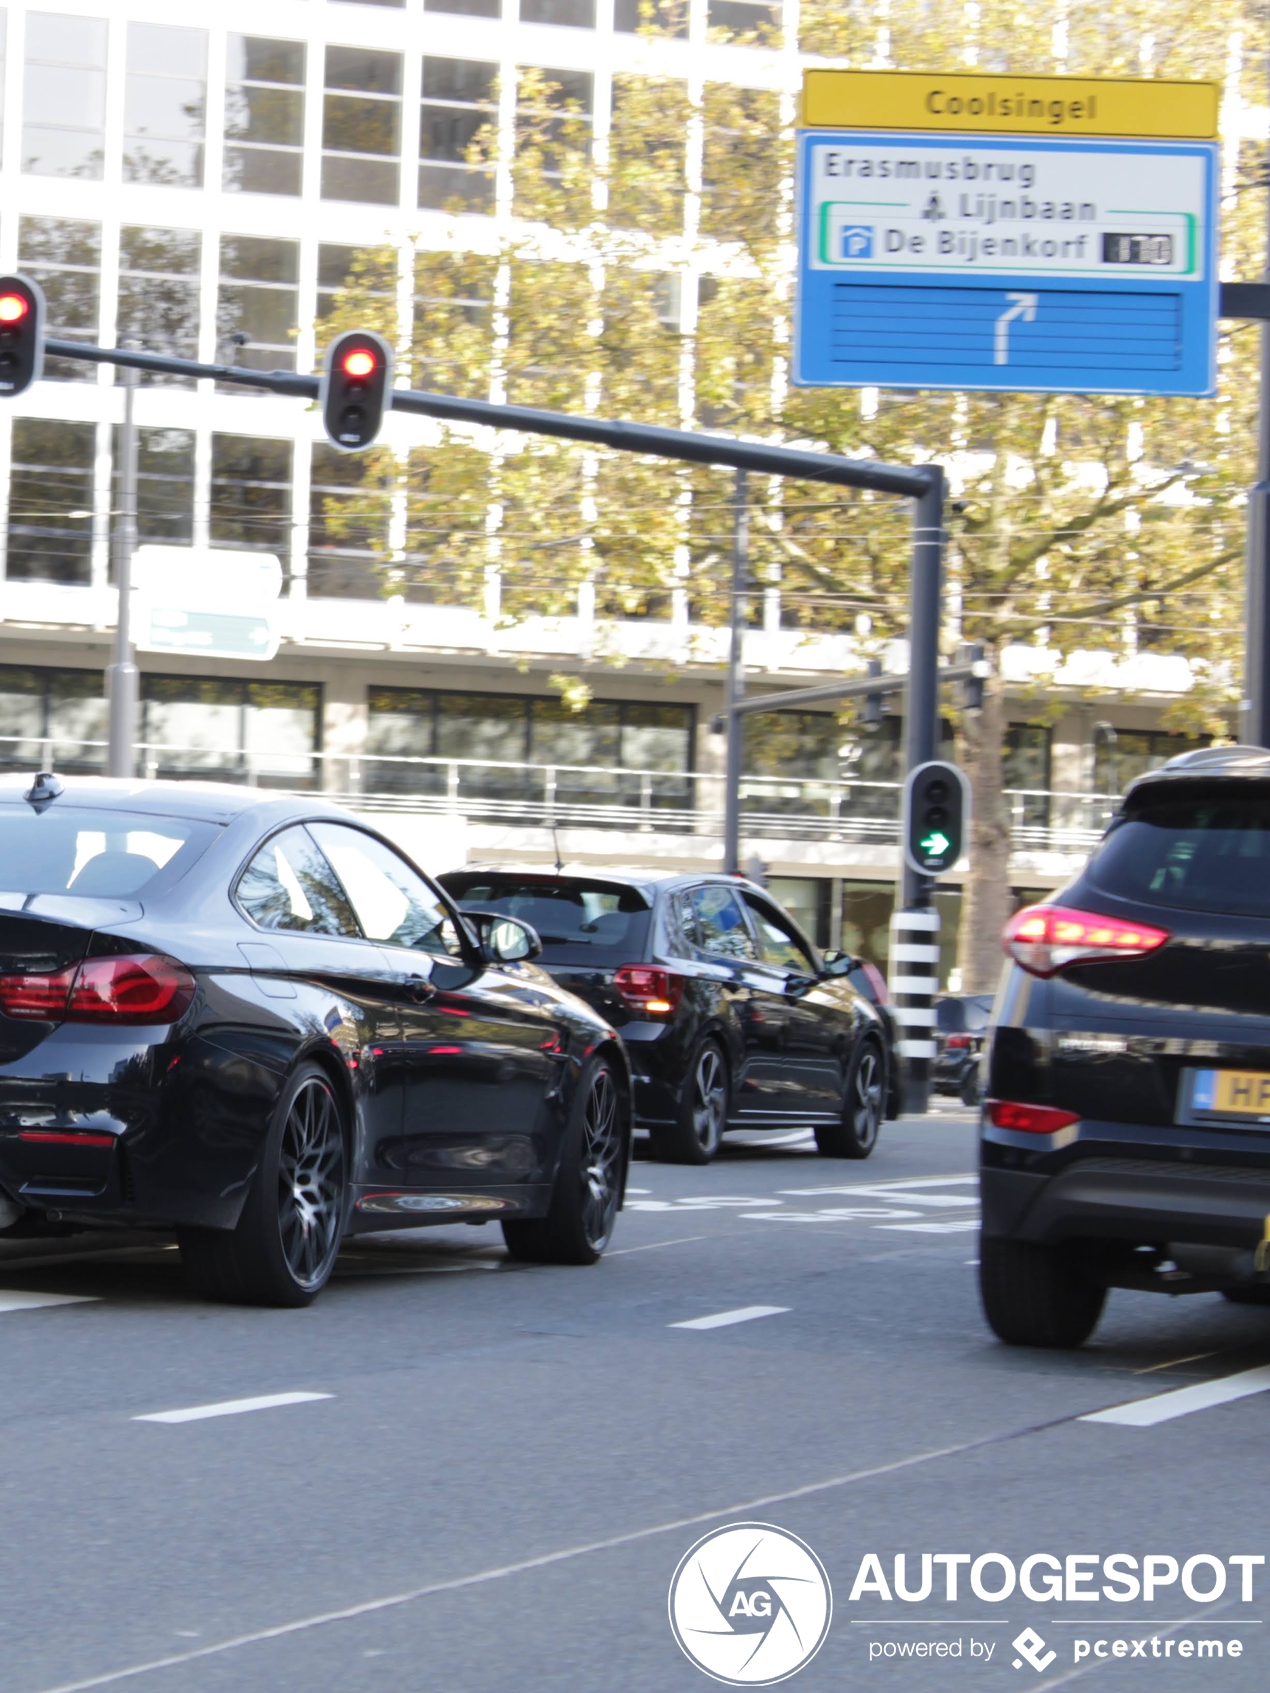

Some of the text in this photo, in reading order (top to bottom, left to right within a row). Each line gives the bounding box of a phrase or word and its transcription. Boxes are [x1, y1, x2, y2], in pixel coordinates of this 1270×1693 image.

[926, 90, 1096, 124] Coolsingel
[825, 152, 1036, 188] Erasmusbrug
[959, 193, 1096, 225] Lijnbaan
[884, 229, 926, 254] De
[937, 230, 1090, 262] Bijenkorf
